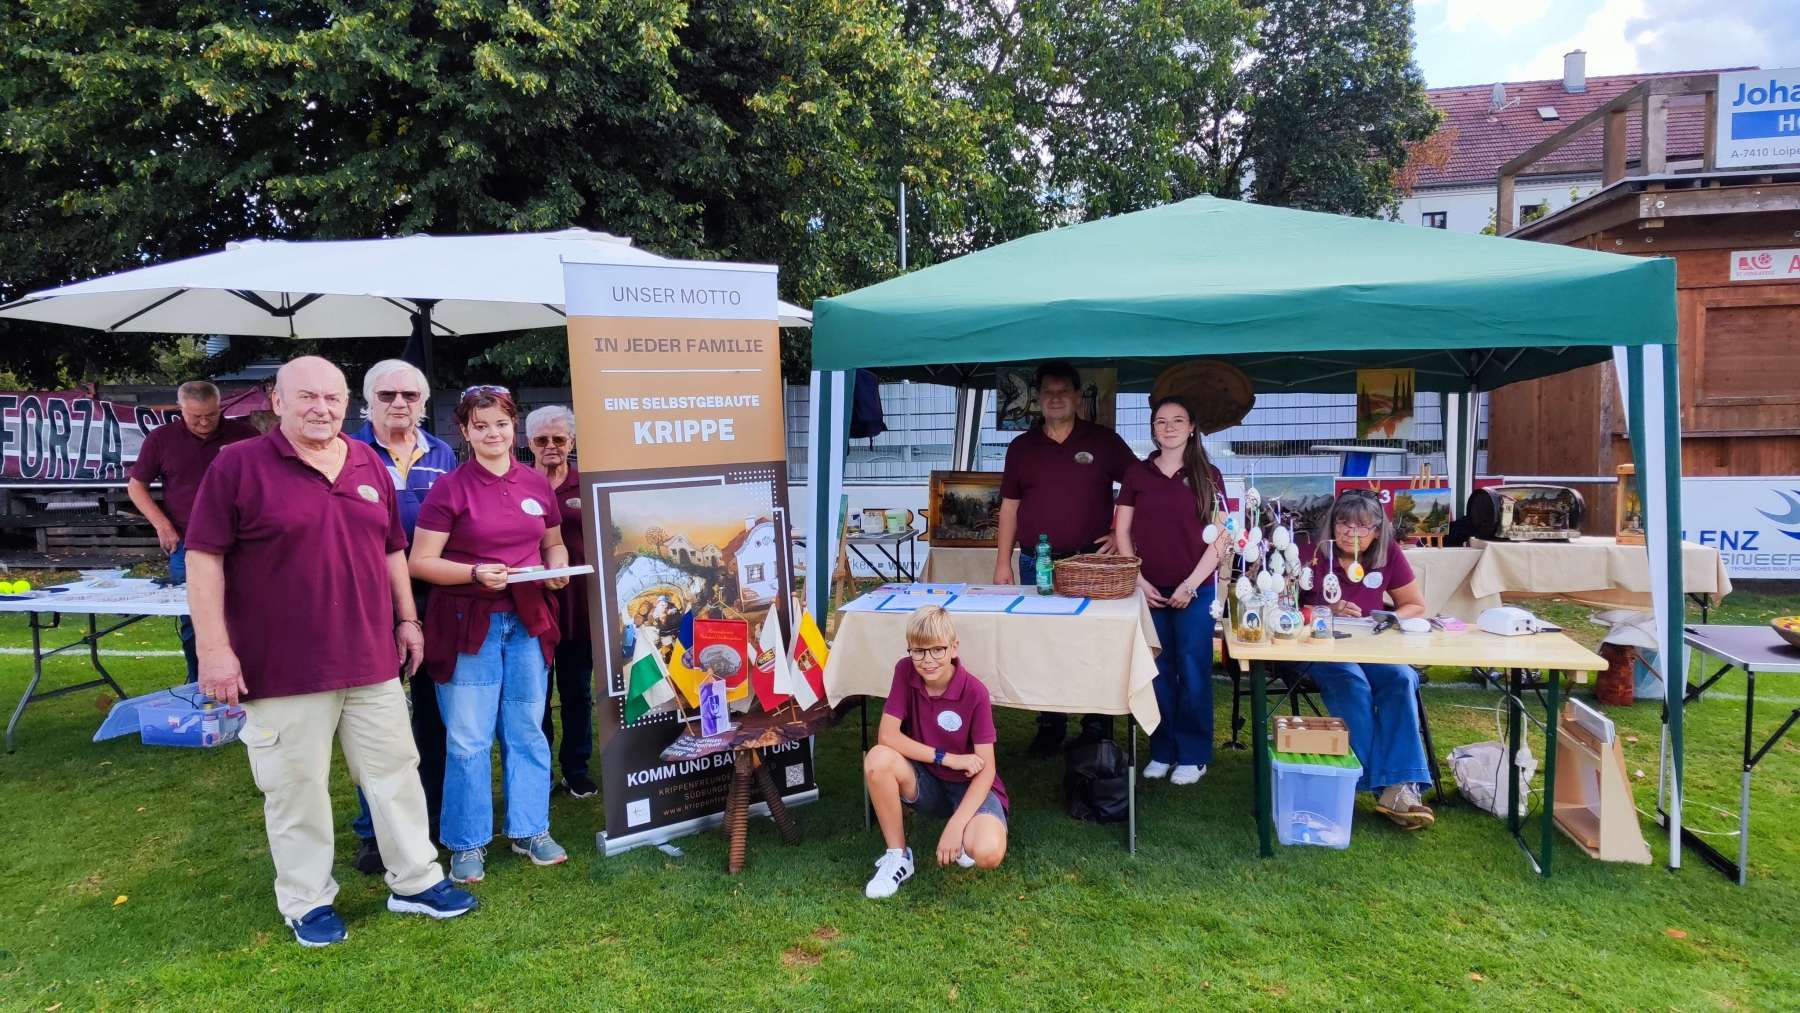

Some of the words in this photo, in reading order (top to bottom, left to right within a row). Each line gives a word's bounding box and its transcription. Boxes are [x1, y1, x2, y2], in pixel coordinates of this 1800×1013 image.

[1779, 113, 1800, 133] H
[1731, 147, 1769, 159] A-7410
[612, 286, 675, 304] UNSER
[681, 288, 741, 306] MOTTO
[594, 337, 618, 353] IN
[624, 338, 681, 353] JEDER
[687, 338, 764, 353] FAMILIE
[604, 397, 640, 411] EINE
[642, 394, 761, 410] SELBSTGEBAUTE
[0, 394, 125, 480] FORZA
[633, 418, 736, 445] KRIPPE
[627, 763, 677, 788] KOMM
[680, 757, 711, 775] UND
